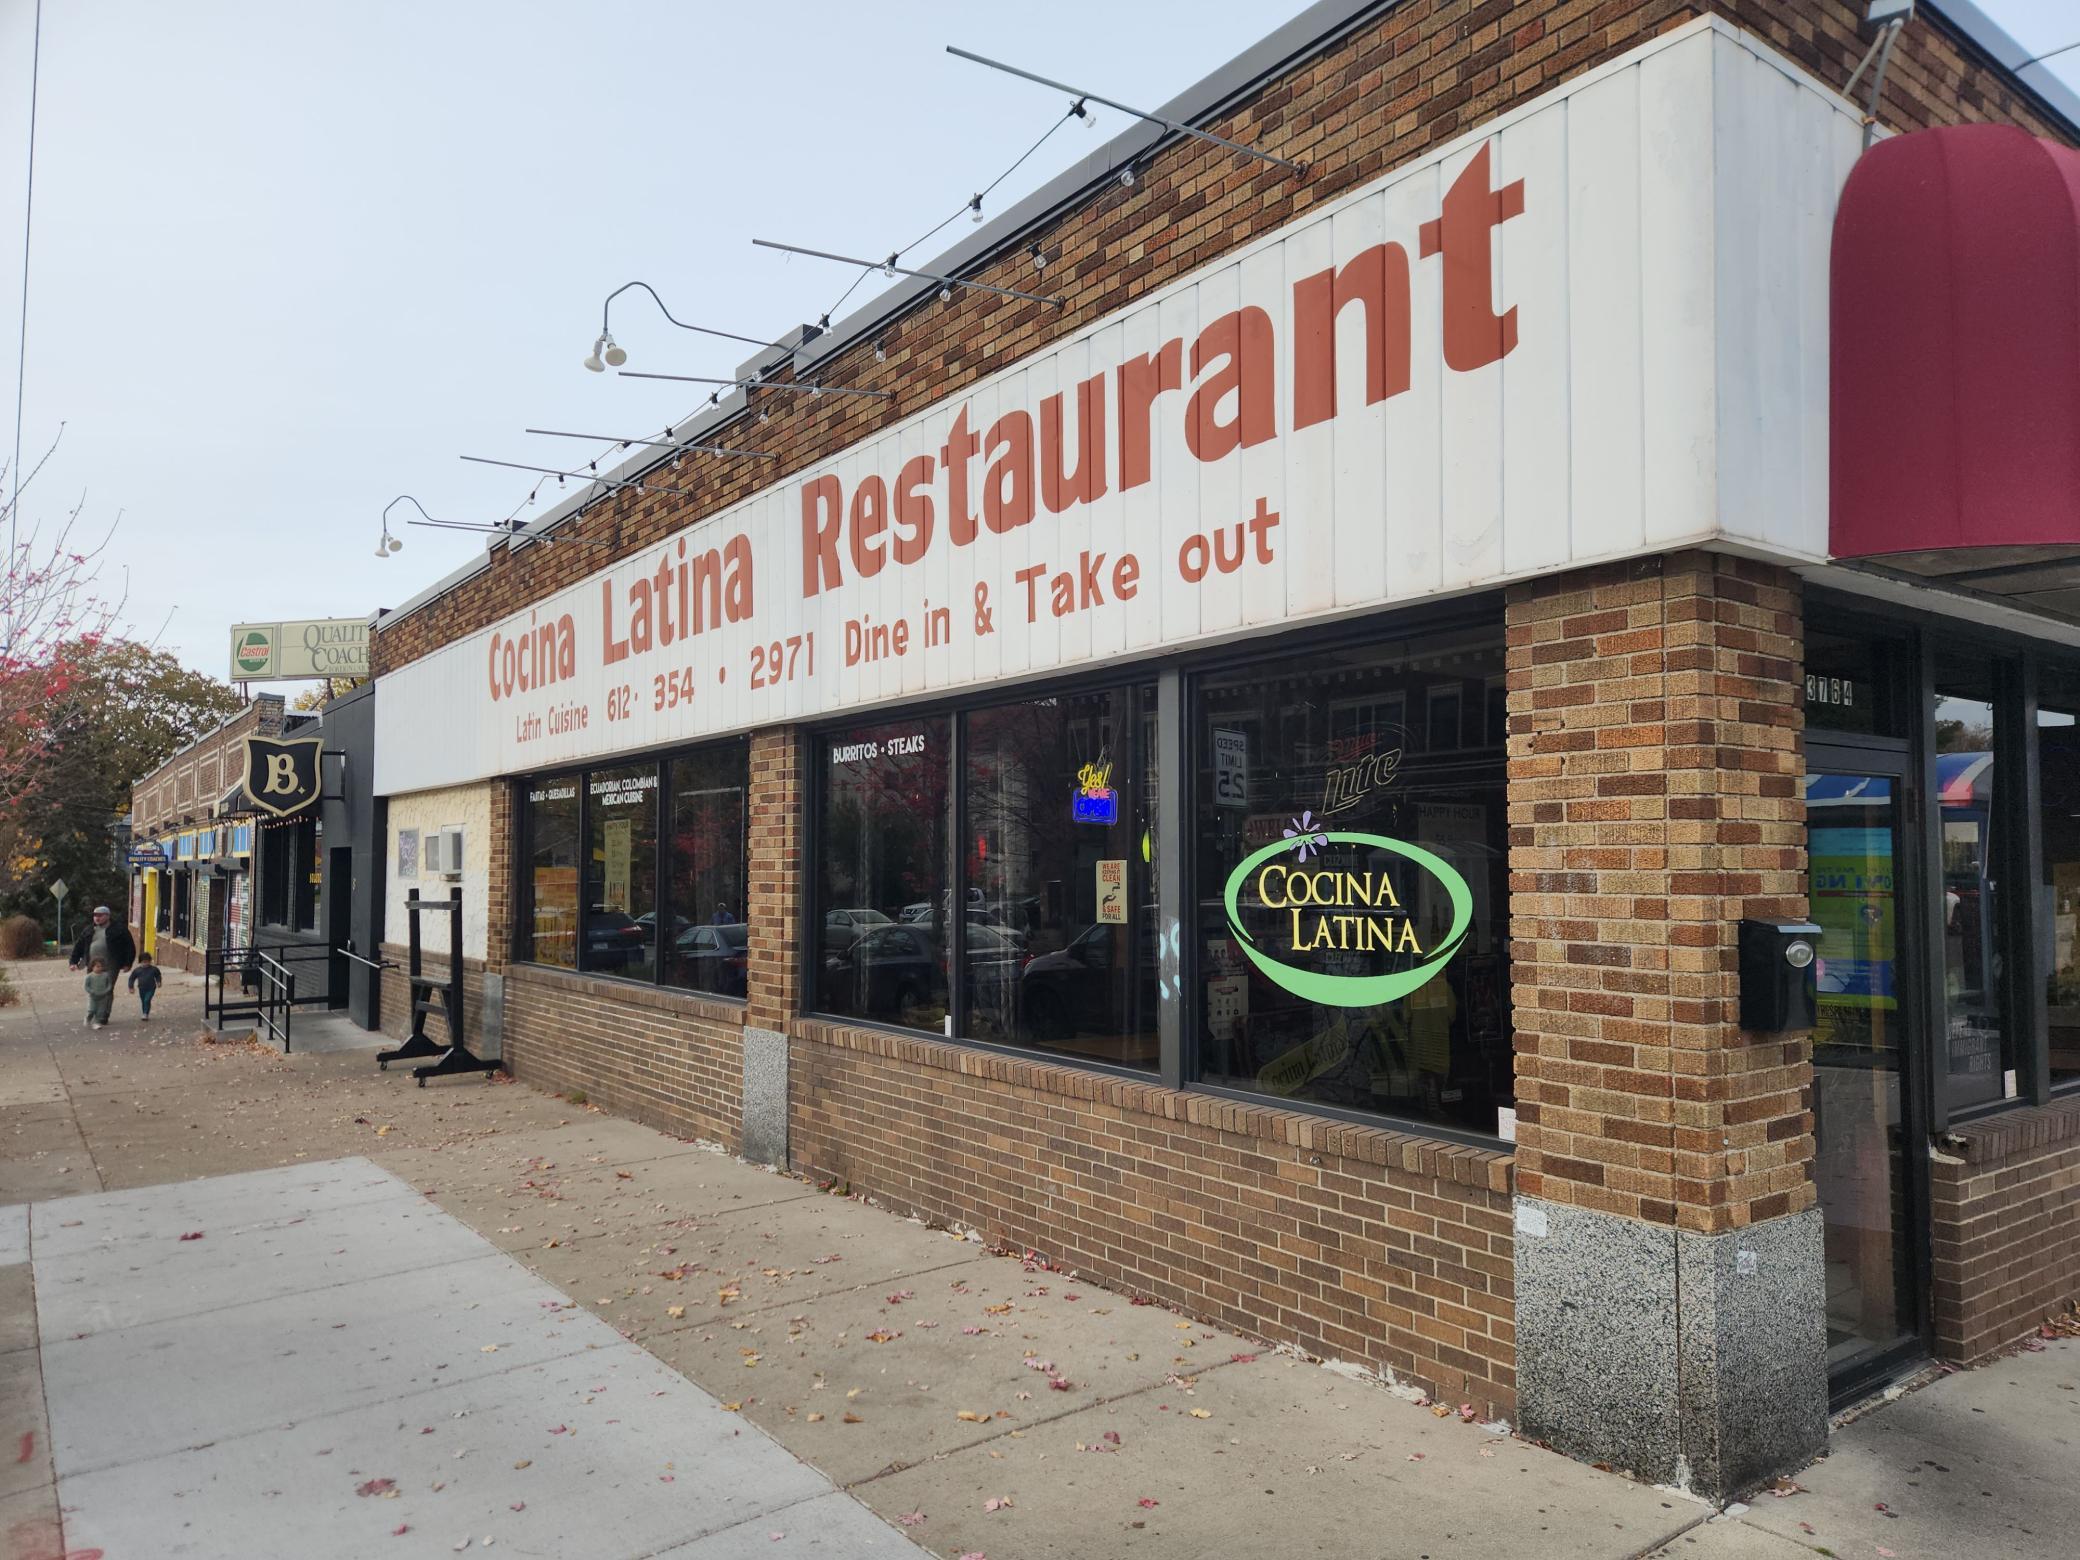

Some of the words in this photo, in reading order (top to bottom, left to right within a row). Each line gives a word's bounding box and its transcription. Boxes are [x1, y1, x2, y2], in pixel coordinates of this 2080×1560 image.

[489, 609, 576, 702] Cocina
[602, 533, 754, 667] Latina
[801, 139, 1525, 599] Restaurant
[516, 712, 542, 743] Latin
[548, 697, 589, 737] Cuisine
[654, 666, 695, 712] 354
[750, 632, 815, 691] 2971
[845, 613, 910, 669] Dine
[923, 598, 951, 650] in
[973, 580, 995, 637] &
[1178, 496, 1280, 584] out
[240, 645, 271, 658] Castrol
[1806, 675, 1853, 706] 3764
[833, 742, 878, 764] BURRITOS
[887, 734, 926, 756] STEAKS
[601, 792, 624, 806] MEXICAN
[624, 790, 644, 804] CUISINE
[1102, 874, 1121, 882] CLEAN
[1107, 905, 1121, 913] SAFE
[1968, 1052, 1992, 1073] RIGHTS
